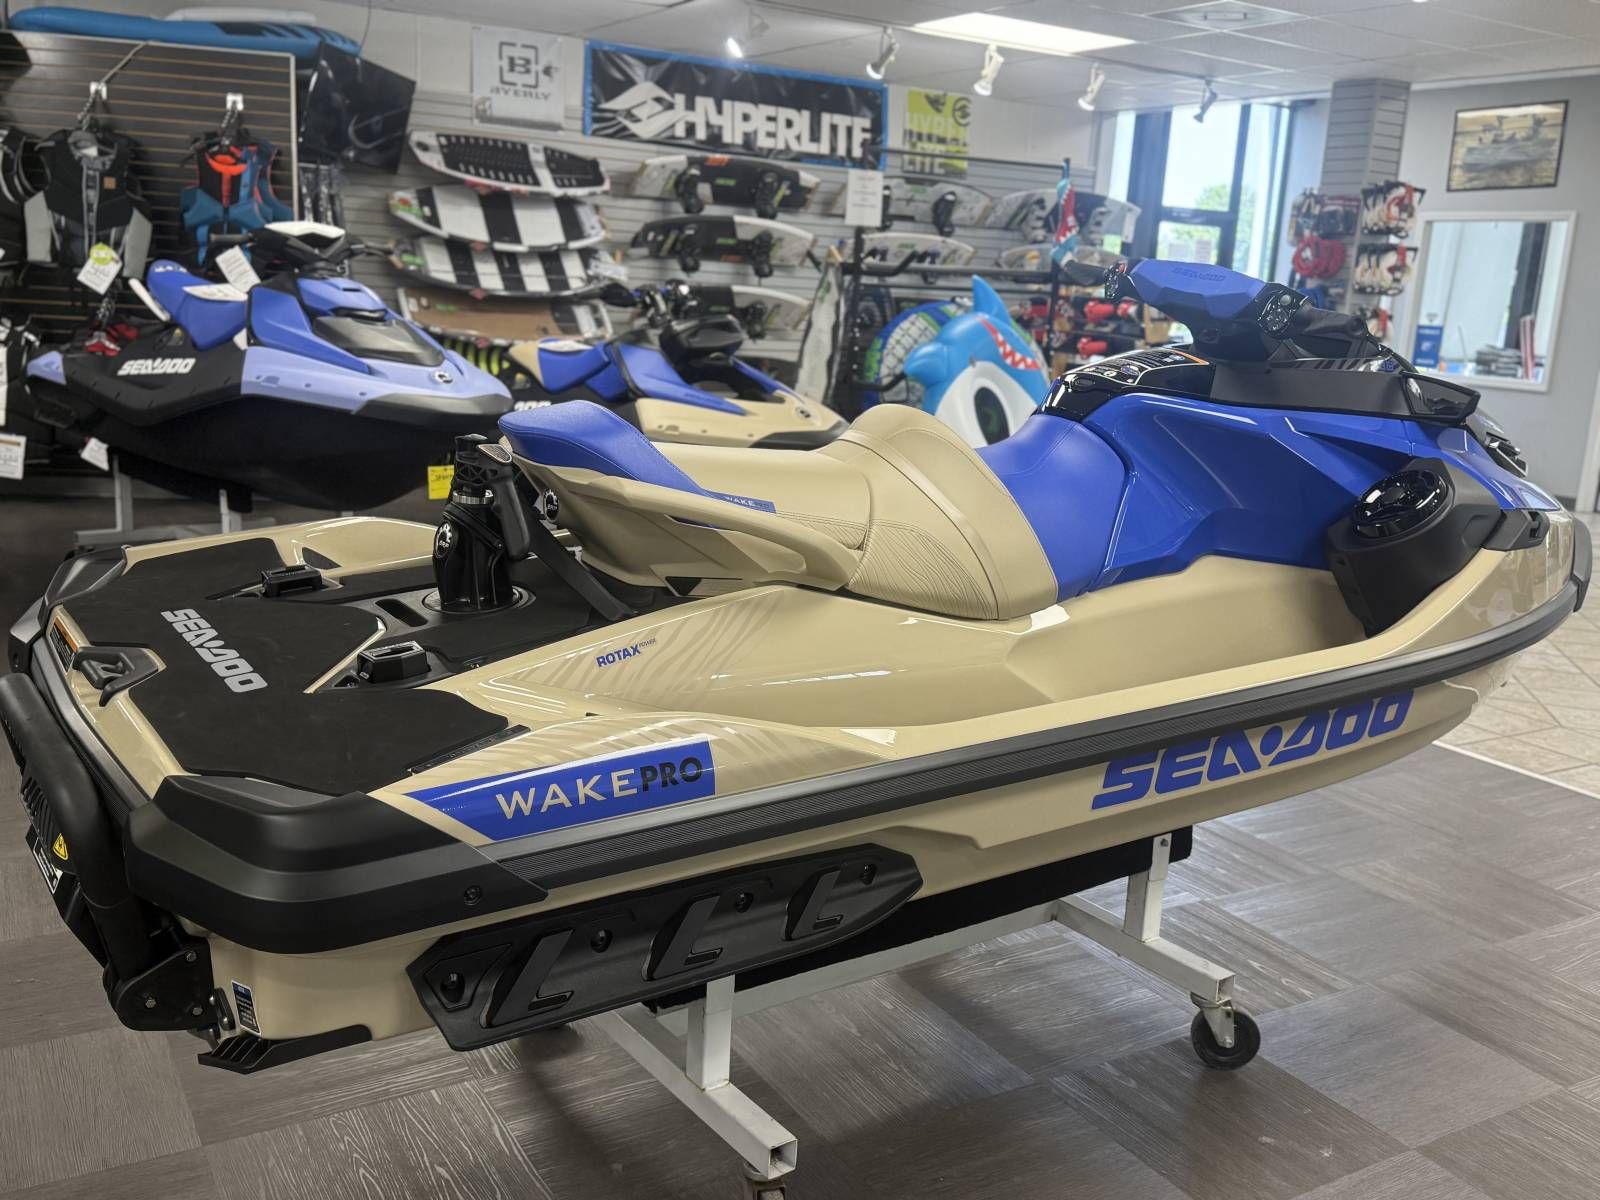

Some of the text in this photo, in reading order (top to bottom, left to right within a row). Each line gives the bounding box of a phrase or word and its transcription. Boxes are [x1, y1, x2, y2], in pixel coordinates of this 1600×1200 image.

[506, 55, 532, 74] B
[673, 93, 872, 158] HYPERLITE
[596, 644, 641, 667] ROTAX
